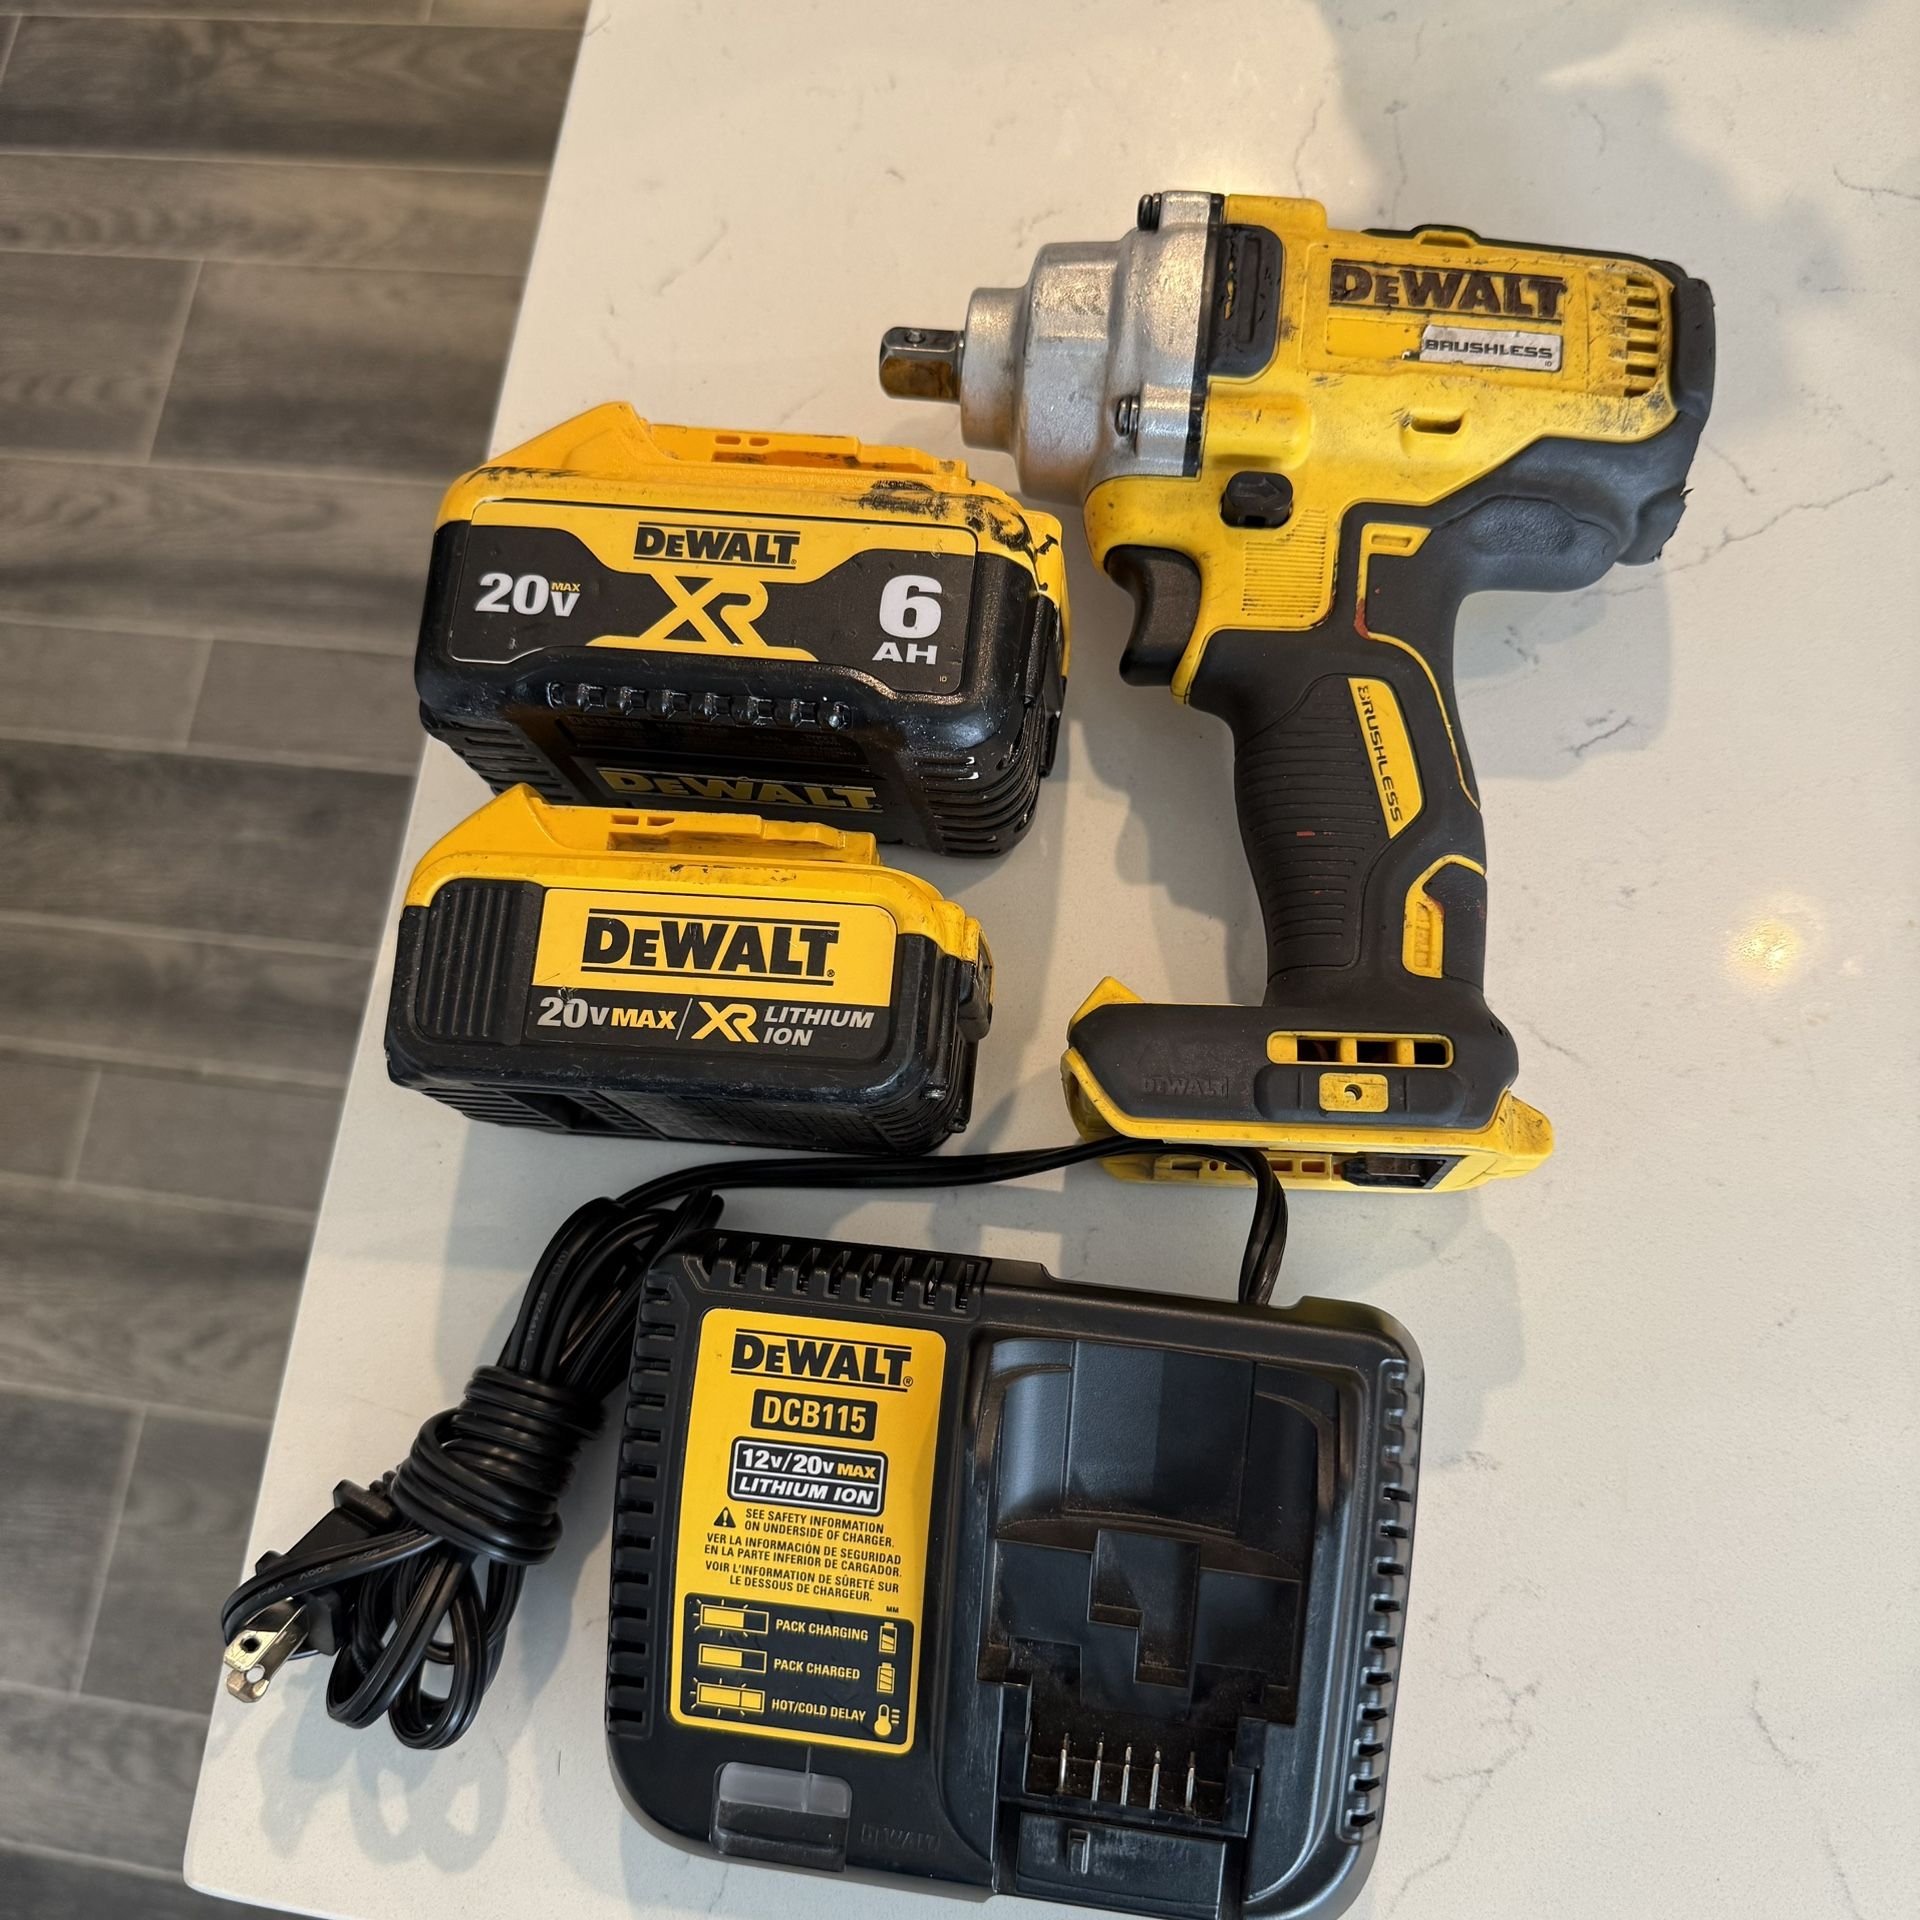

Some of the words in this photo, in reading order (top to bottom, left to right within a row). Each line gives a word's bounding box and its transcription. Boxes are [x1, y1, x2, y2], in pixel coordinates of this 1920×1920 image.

[1423, 338, 1553, 360] BRUSHLESS
[551, 581, 580, 593] MAX
[638, 572, 771, 648] XR
[879, 575, 942, 638] 6
[872, 642, 938, 665] AH
[1357, 685, 1403, 822] BRUSHLESS
[691, 1001, 759, 1044] XR
[763, 1006, 875, 1030] LITHIUM
[763, 1027, 813, 1047] ION
[762, 1395, 867, 1434] DCB115
[837, 1463, 876, 1479] MAX
[739, 1476, 829, 1500] LITHIUM
[833, 1488, 874, 1505] ION
[744, 1520, 761, 1531] ON
[764, 1522, 823, 1539] UNDERSIDE
[826, 1528, 840, 1540] OF
[842, 1531, 895, 1548] CHARGER.
[746, 1508, 765, 1520] SEE
[768, 1510, 808, 1524] SAFETY
[810, 1513, 884, 1534] INFORMATION
[704, 1544, 718, 1554] EN
[722, 1546, 734, 1557] LA
[737, 1548, 771, 1561] PARTE
[773, 1552, 822, 1568] INFERIOR
[824, 1558, 838, 1569] DE
[841, 1560, 902, 1577] CARGADOR.
[706, 1532, 727, 1544] VER
[730, 1535, 742, 1546] LA
[745, 1536, 820, 1554] INFORMACIÓN
[824, 1546, 836, 1557] DE
[840, 1548, 901, 1565] SEGURIDAD
[705, 1560, 730, 1572] VOIR
[732, 1562, 816, 1582] L'INFORMATION
[818, 1571, 832, 1584] DE
[835, 1573, 875, 1590] SÛRETÉ
[878, 1580, 899, 1593] SUR
[730, 1574, 742, 1585] LE
[744, 1577, 793, 1592] DESSOUS
[796, 1582, 810, 1594] DE
[813, 1584, 873, 1601] CHARGEUR.
[886, 1606, 900, 1614] MM
[776, 1618, 806, 1632] PACK
[808, 1622, 868, 1641] CHARGING
[774, 1658, 804, 1672] PACK
[806, 1662, 860, 1680] CHARGED
[772, 1698, 828, 1716] HOT/COLD
[830, 1706, 866, 1722] DELAY
